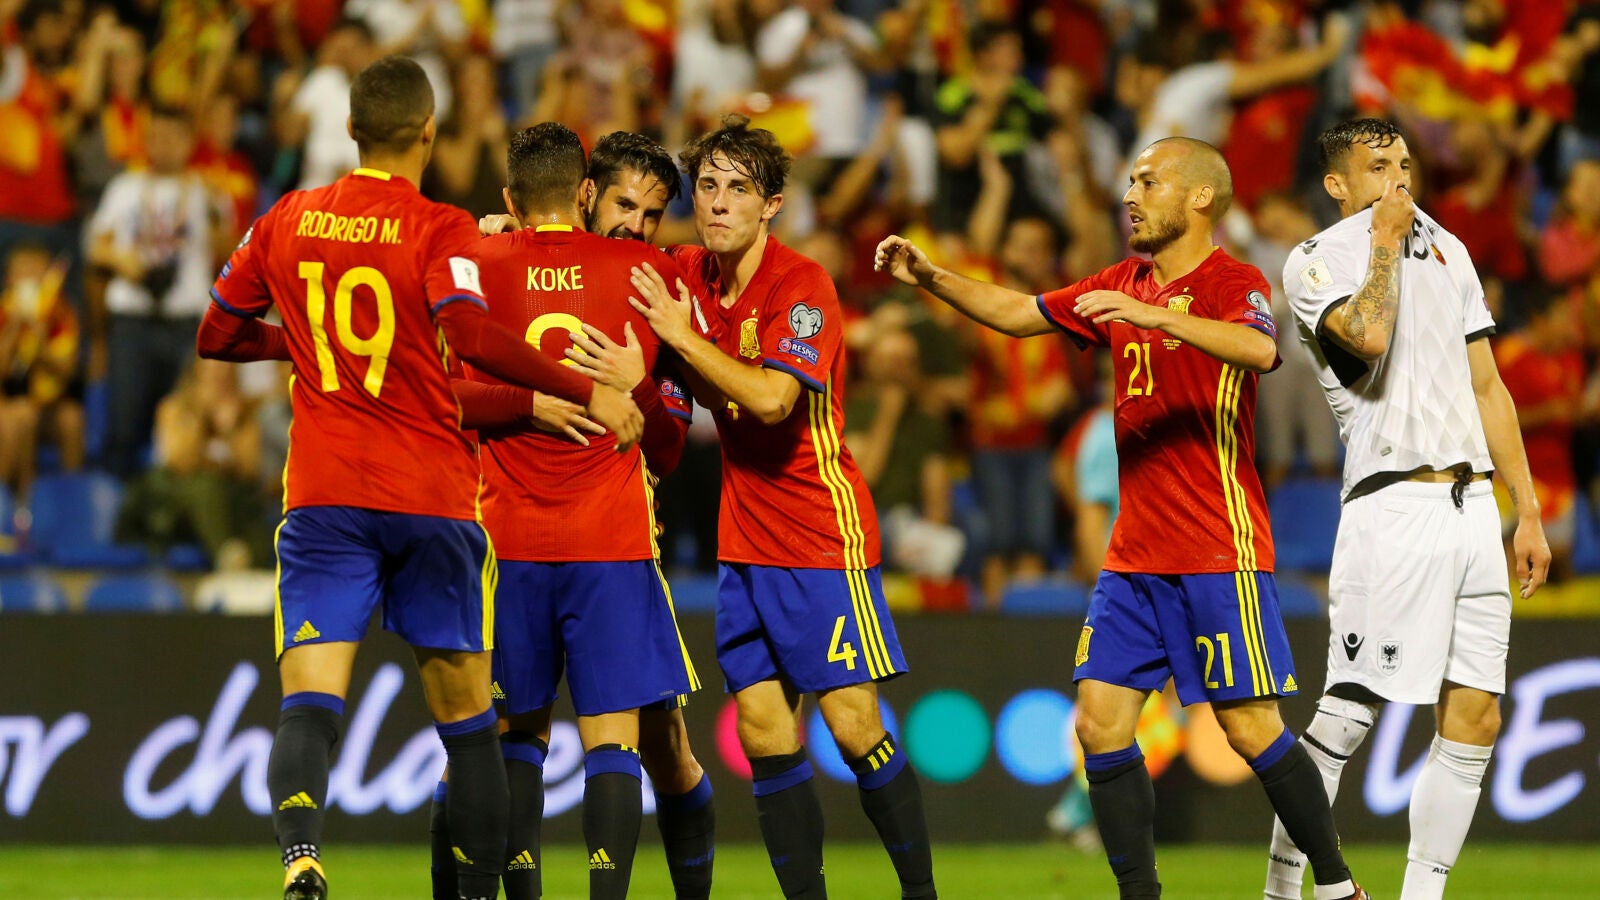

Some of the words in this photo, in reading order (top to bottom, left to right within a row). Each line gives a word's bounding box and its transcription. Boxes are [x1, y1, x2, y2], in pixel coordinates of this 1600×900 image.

[297, 210, 377, 244] RODRIGO
[379, 218, 402, 244] M.
[526, 265, 584, 291] KOKE
[298, 261, 396, 398] 19
[791, 343, 818, 361] RESPECT
[1123, 341, 1154, 396] 21
[827, 615, 858, 671] 4
[1195, 632, 1235, 689] 21
[508, 861, 536, 870] adidas
